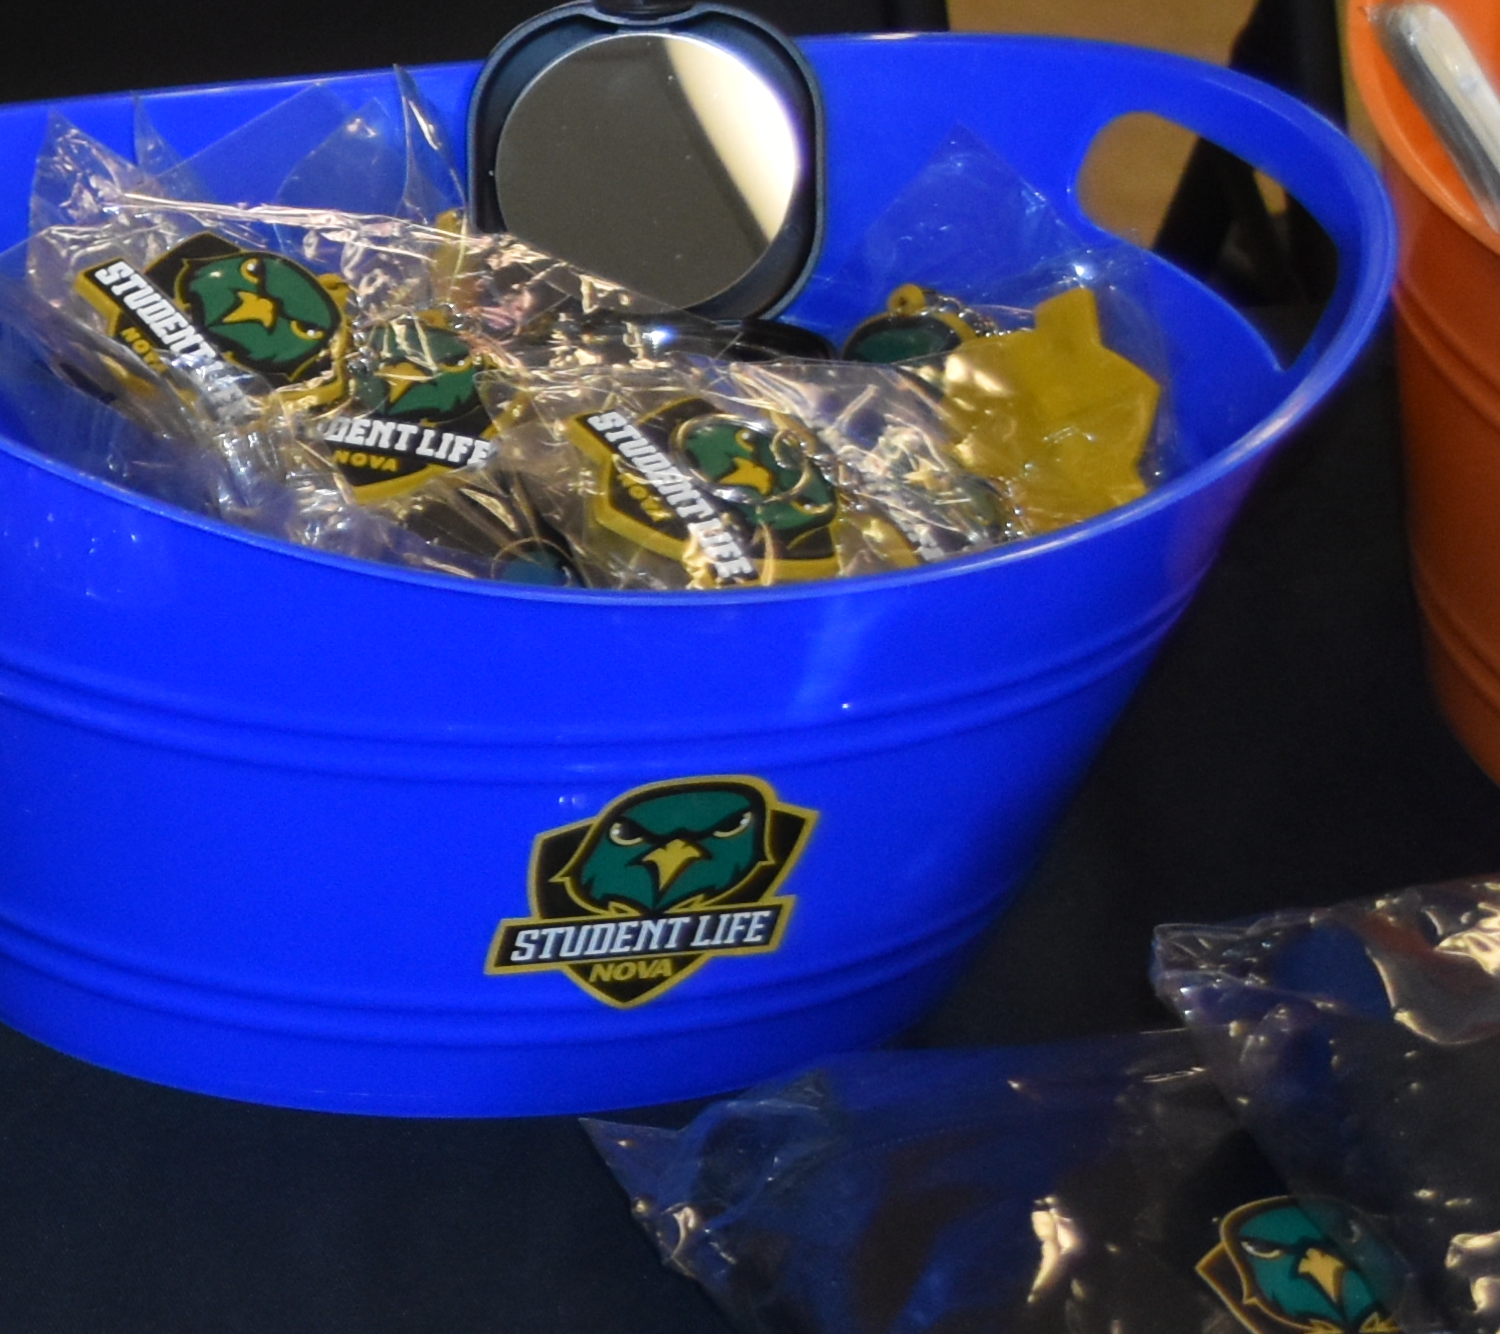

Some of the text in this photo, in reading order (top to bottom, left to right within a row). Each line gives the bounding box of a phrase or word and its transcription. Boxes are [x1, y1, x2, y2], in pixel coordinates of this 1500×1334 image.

[94, 261, 216, 366] STUDENT
[317, 417, 497, 470] DENT LIFE
[332, 448, 399, 473] NOVA
[587, 411, 714, 519] STUDENT
[510, 910, 774, 962] STUDENT LIFE
[589, 958, 675, 984] NOVA
